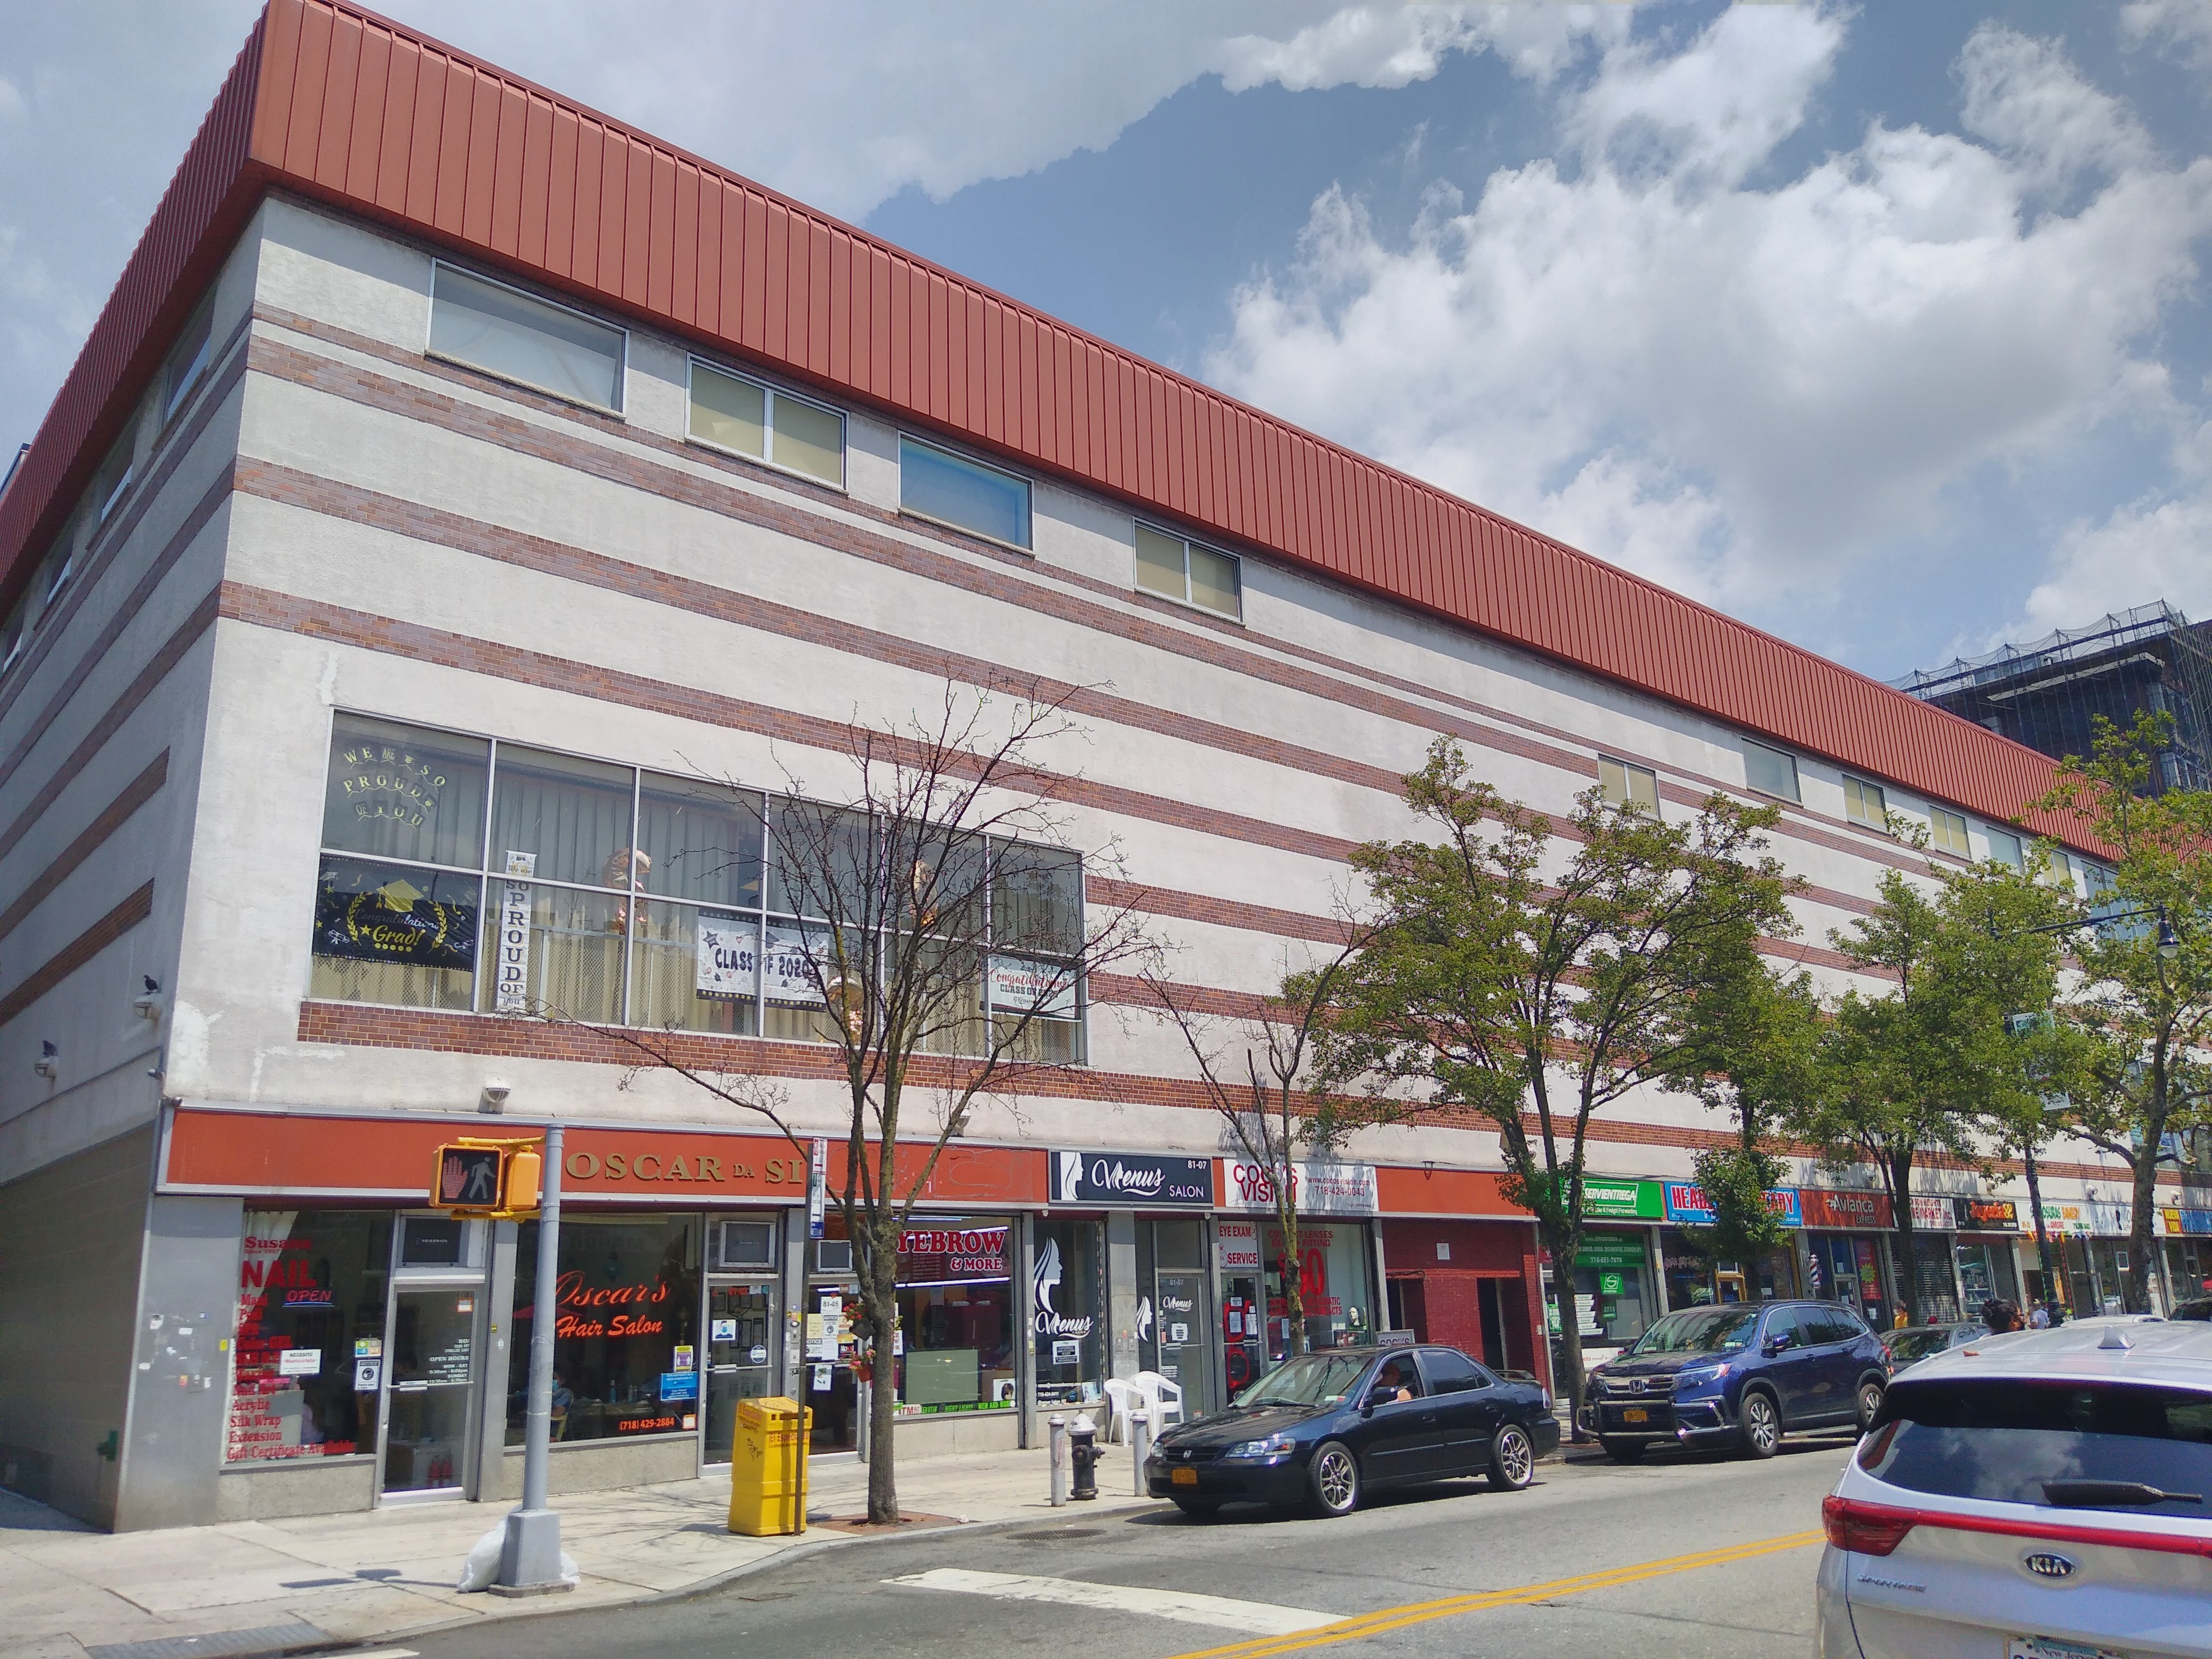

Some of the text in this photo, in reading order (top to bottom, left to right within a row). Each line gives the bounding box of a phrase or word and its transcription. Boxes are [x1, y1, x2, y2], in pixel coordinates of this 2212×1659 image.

[343, 747, 446, 787] WE ARE SO
[343, 775, 423, 797] PROUD
[356, 804, 423, 825] OF YOU
[506, 880, 529, 891] SO
[372, 925, 426, 946] Grad!
[504, 891, 527, 982] PROUD
[715, 947, 753, 972] CLASS
[779, 955, 811, 979] 2020
[500, 983, 523, 993] OF
[1000, 983, 1026, 995] CLASS
[503, 998, 520, 1006] you
[566, 1151, 726, 1182] OSCAR
[733, 1163, 755, 1178] DA
[1188, 1159, 1207, 1169] 81-07
[1091, 1159, 1165, 1190] Venus
[1307, 1176, 1371, 1186] www.cocosvision.com
[1169, 1184, 1205, 1197] SALON
[1315, 1185, 1365, 1197] 718-424-0043
[1584, 1188, 1636, 1201] SERVIENTREGA
[1833, 1194, 1874, 1213] Avianca
[1856, 1215, 1876, 1224] EXPRESS
[1219, 1225, 1252, 1237] EYE EXAM
[1305, 1230, 1333, 1238] LENSES
[896, 1230, 1006, 1253] YEBROW
[951, 1257, 1003, 1271] & MORE
[1228, 1252, 1258, 1264] SERVICE
[241, 1259, 318, 1288] NAIL
[556, 1270, 671, 1306] Oscar's
[286, 1290, 332, 1302] OPEN
[1163, 1296, 1193, 1309] Venus
[556, 1313, 663, 1338] Hair Salon
[1035, 1311, 1094, 1334] Venus
[978, 1402, 988, 1410] MEN
[230, 1414, 282, 1429] Silk Wrap
[620, 1417, 675, 1431] (718) 429-2884
[229, 1431, 282, 1443] Extension
[770, 1432, 775, 1442] El
[2031, 1556, 2067, 1575] KIA
